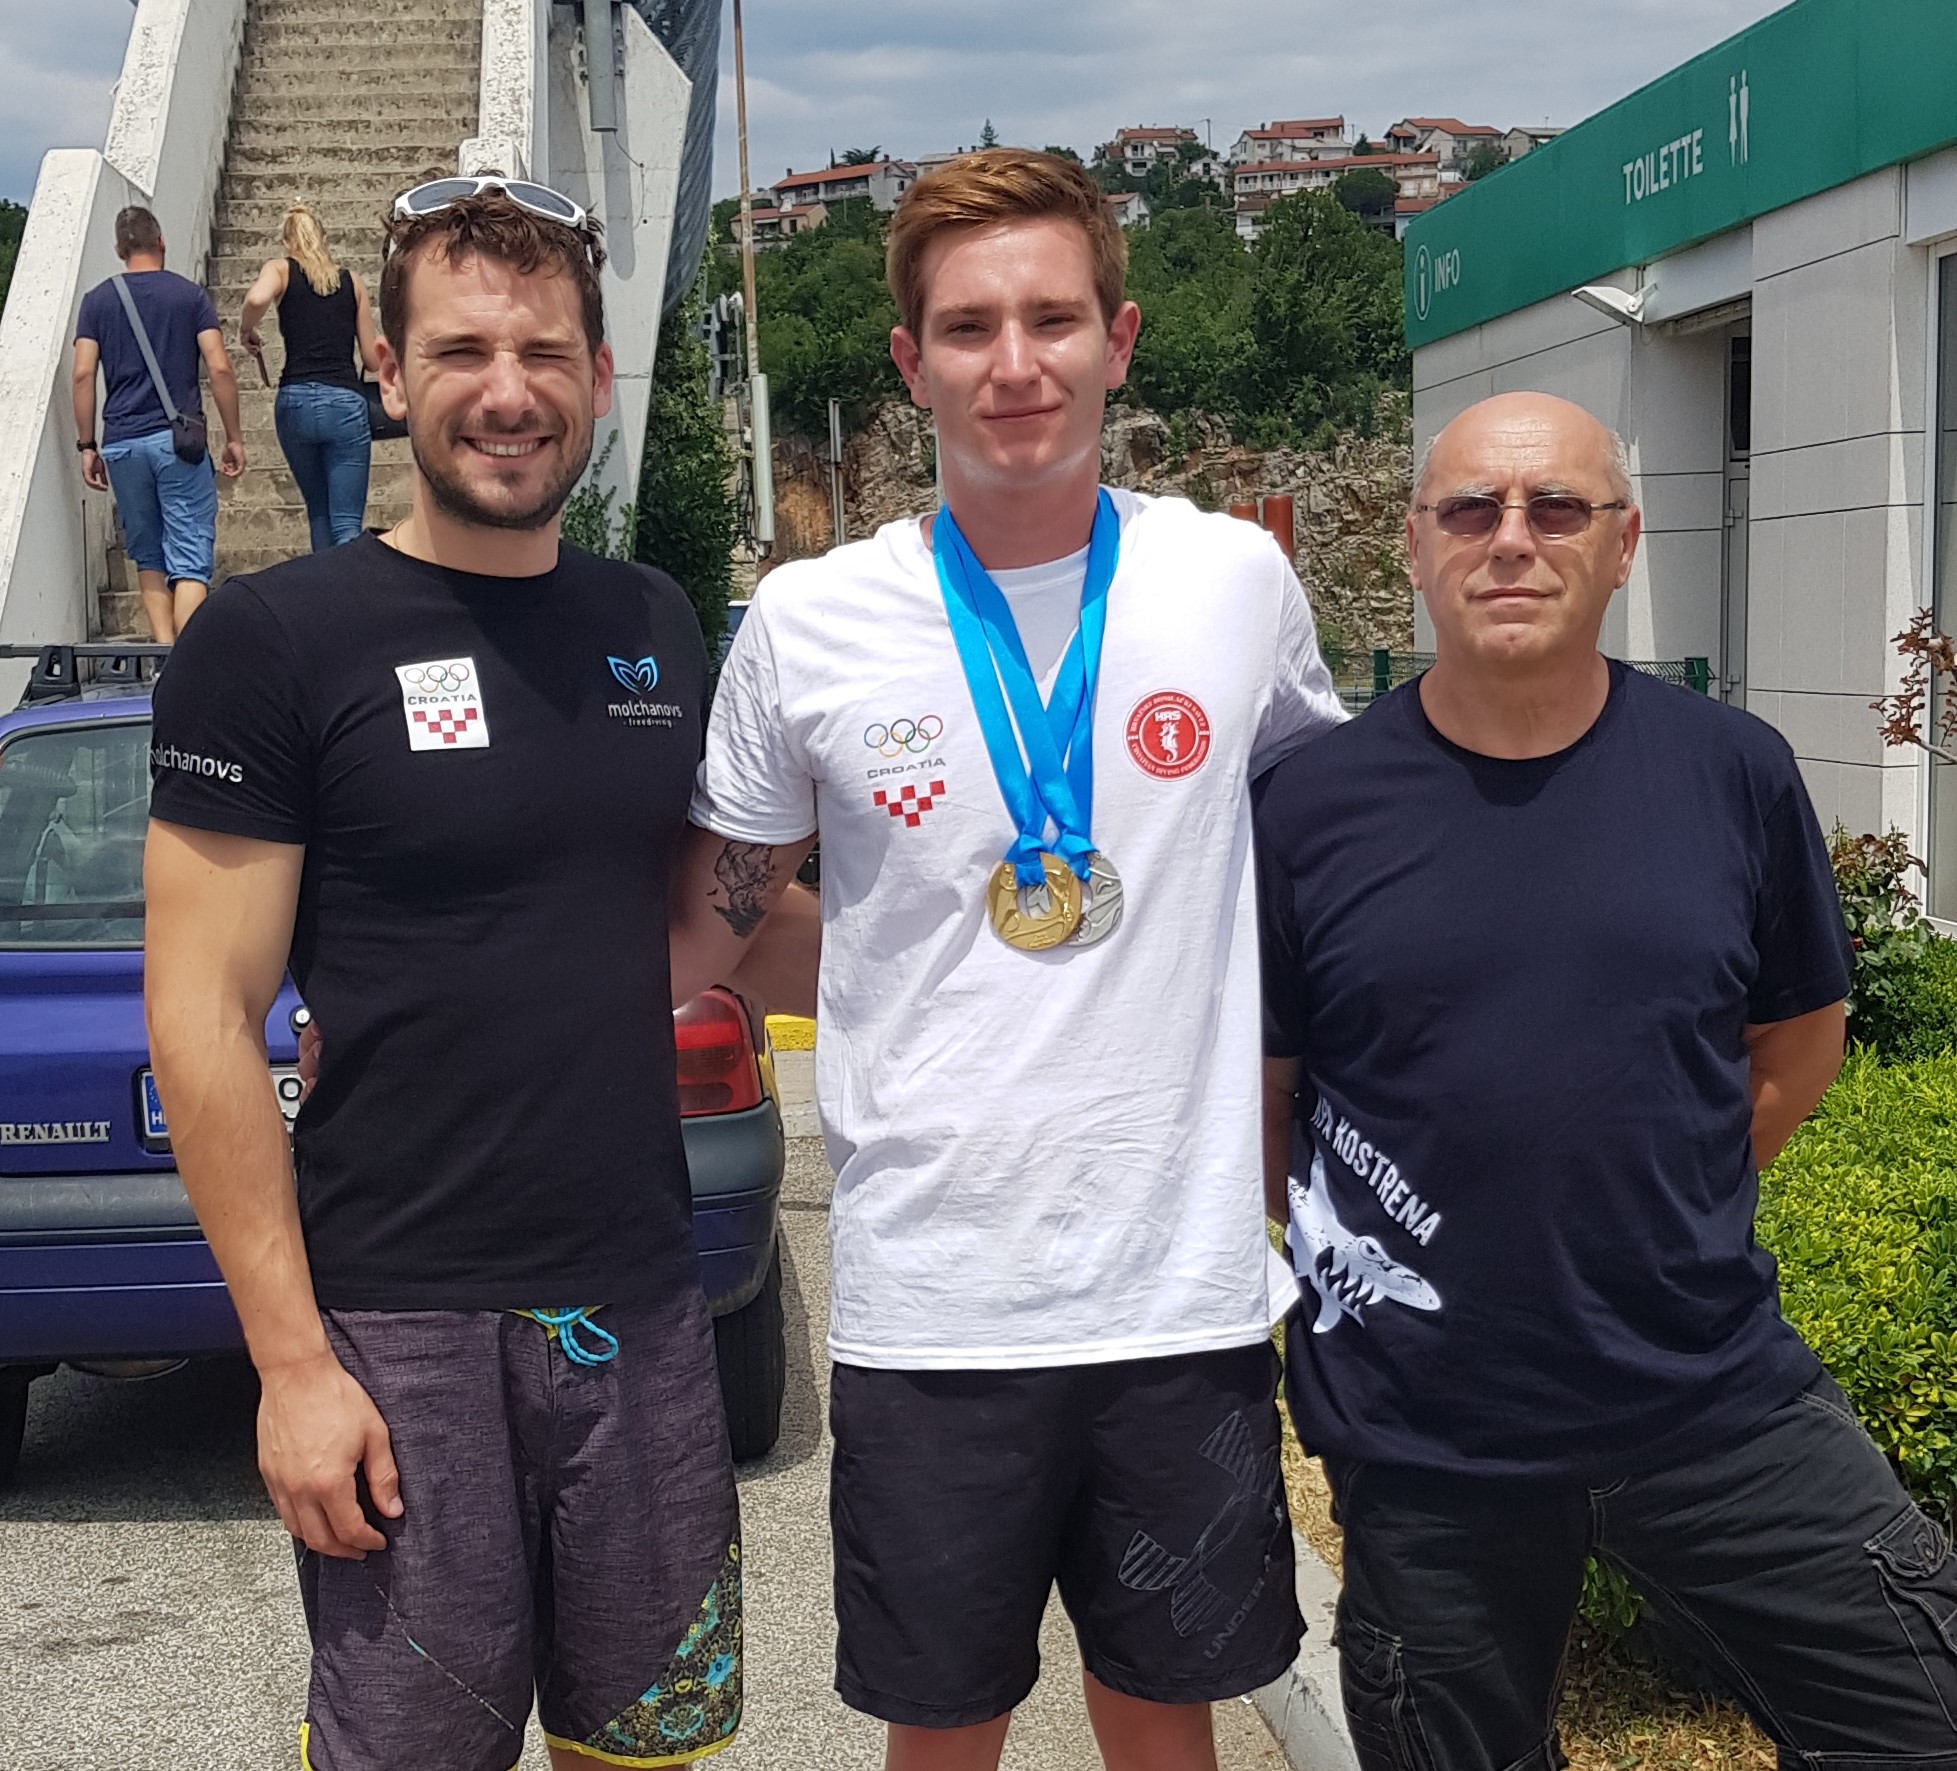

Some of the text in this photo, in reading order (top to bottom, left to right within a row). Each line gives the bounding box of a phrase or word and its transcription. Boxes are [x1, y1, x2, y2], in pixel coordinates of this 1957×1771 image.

[1622, 128, 1704, 205] TOILETTE
[1434, 248, 1460, 293] INFO
[407, 693, 477, 706] CROATIA
[607, 699, 683, 718] molchanovs
[866, 757, 946, 779] CROATIA
[0, 1121, 111, 1145] RENAULT
[1332, 1115, 1442, 1248] KOSTRENA
